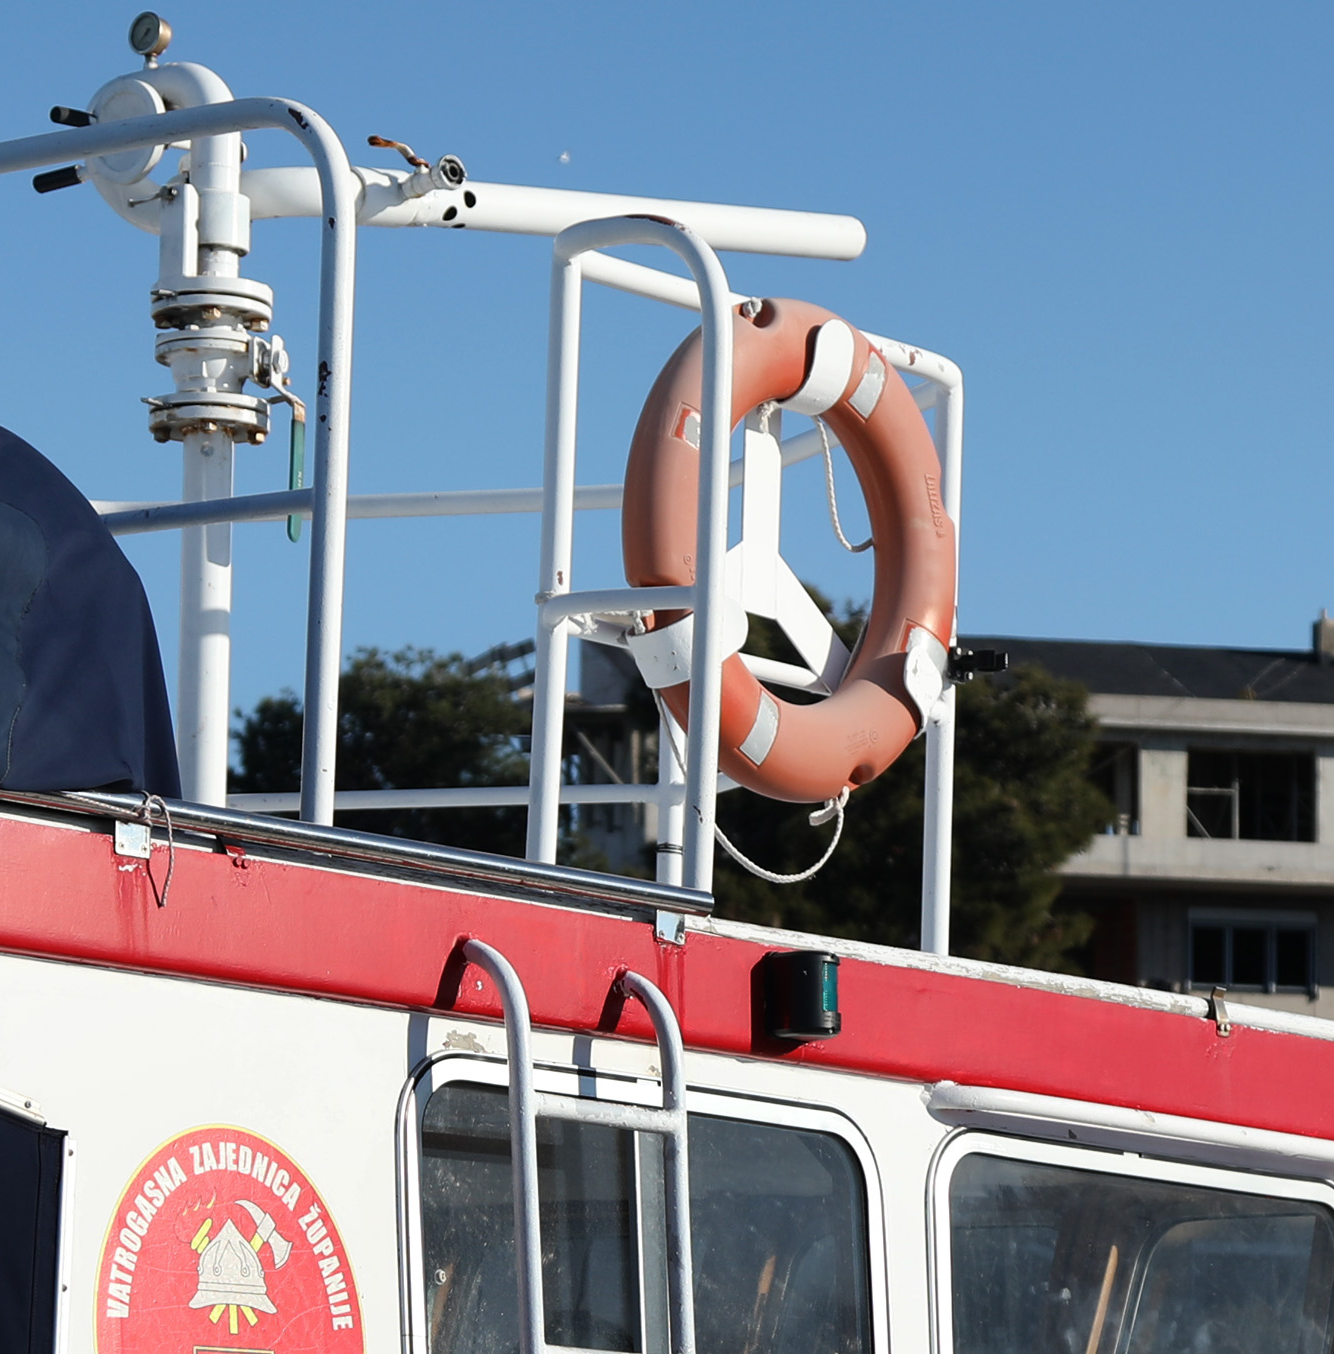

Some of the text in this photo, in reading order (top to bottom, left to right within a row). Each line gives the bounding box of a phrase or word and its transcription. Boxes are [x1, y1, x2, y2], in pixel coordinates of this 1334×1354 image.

[106, 1141, 354, 1331] VATROGASNA ZAJEDNICA ŽUPANIJE
